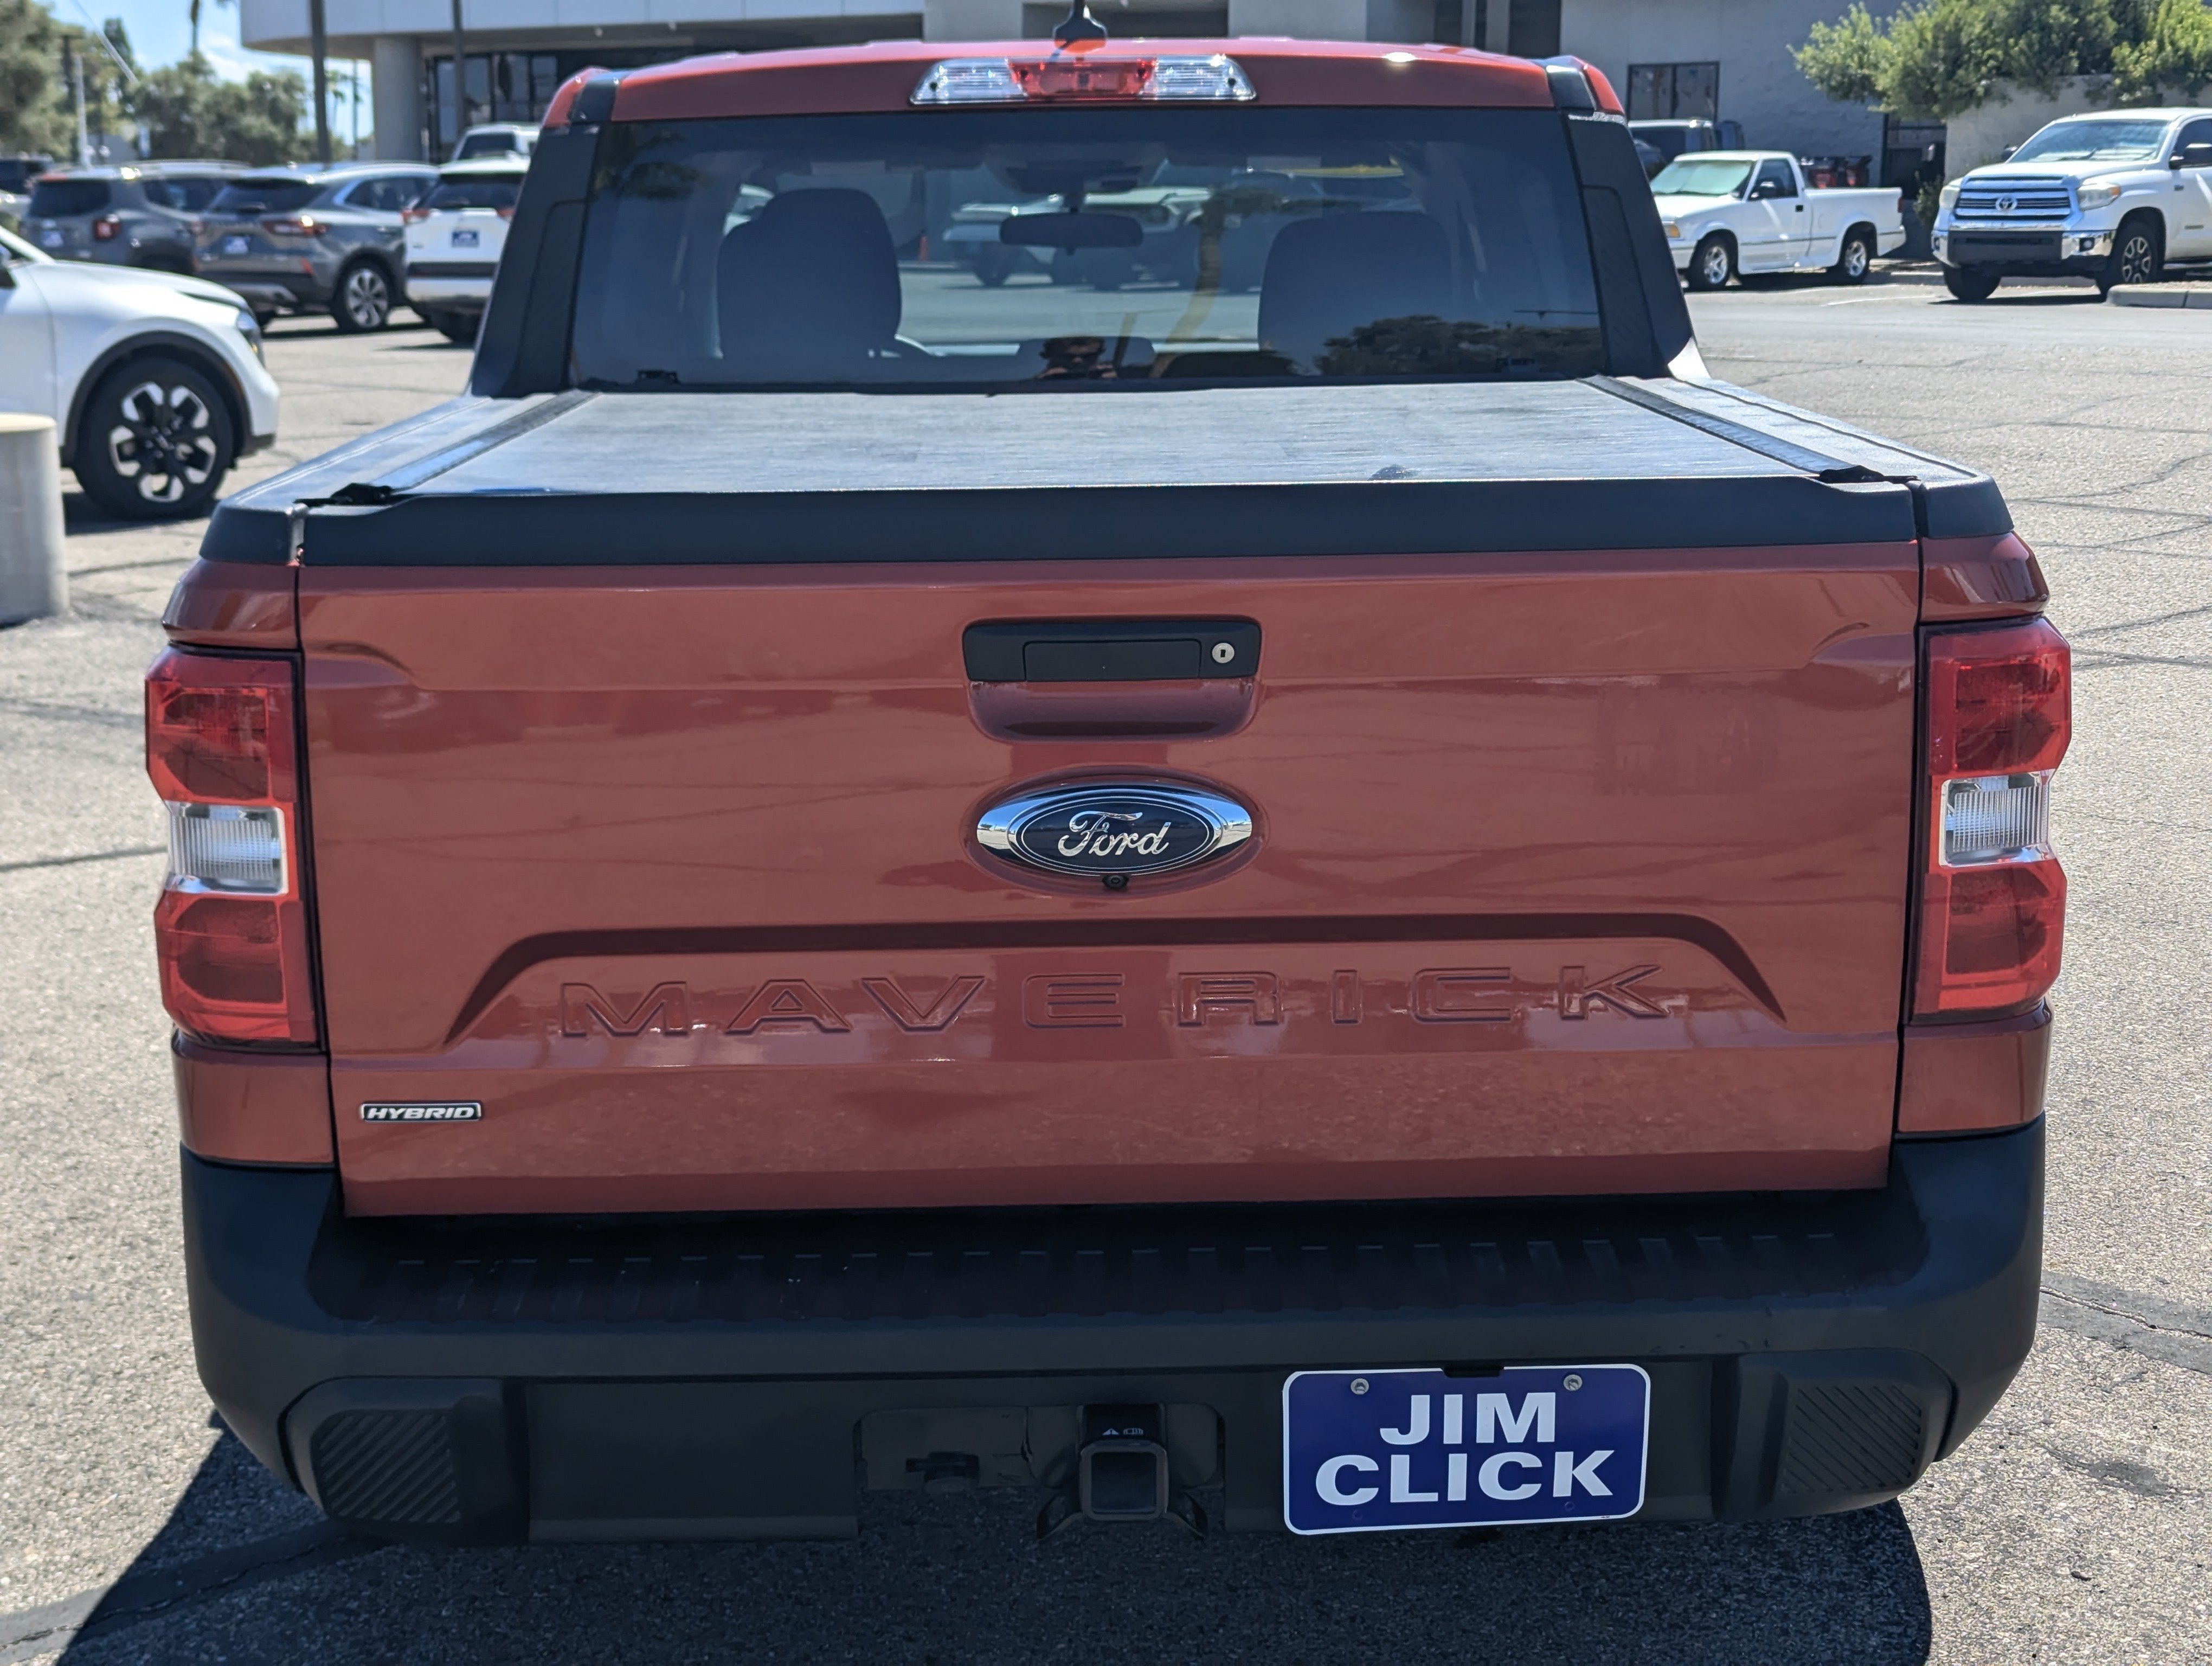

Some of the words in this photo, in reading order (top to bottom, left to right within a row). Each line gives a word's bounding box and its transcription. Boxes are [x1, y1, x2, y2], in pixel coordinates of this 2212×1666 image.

[1057, 810, 1172, 857] Ford
[560, 964, 1669, 1036] MAVERICK
[366, 1107, 474, 1119] HYBRID
[1379, 1392, 1556, 1445] JIM
[1315, 1450, 1615, 1506] CLICK
